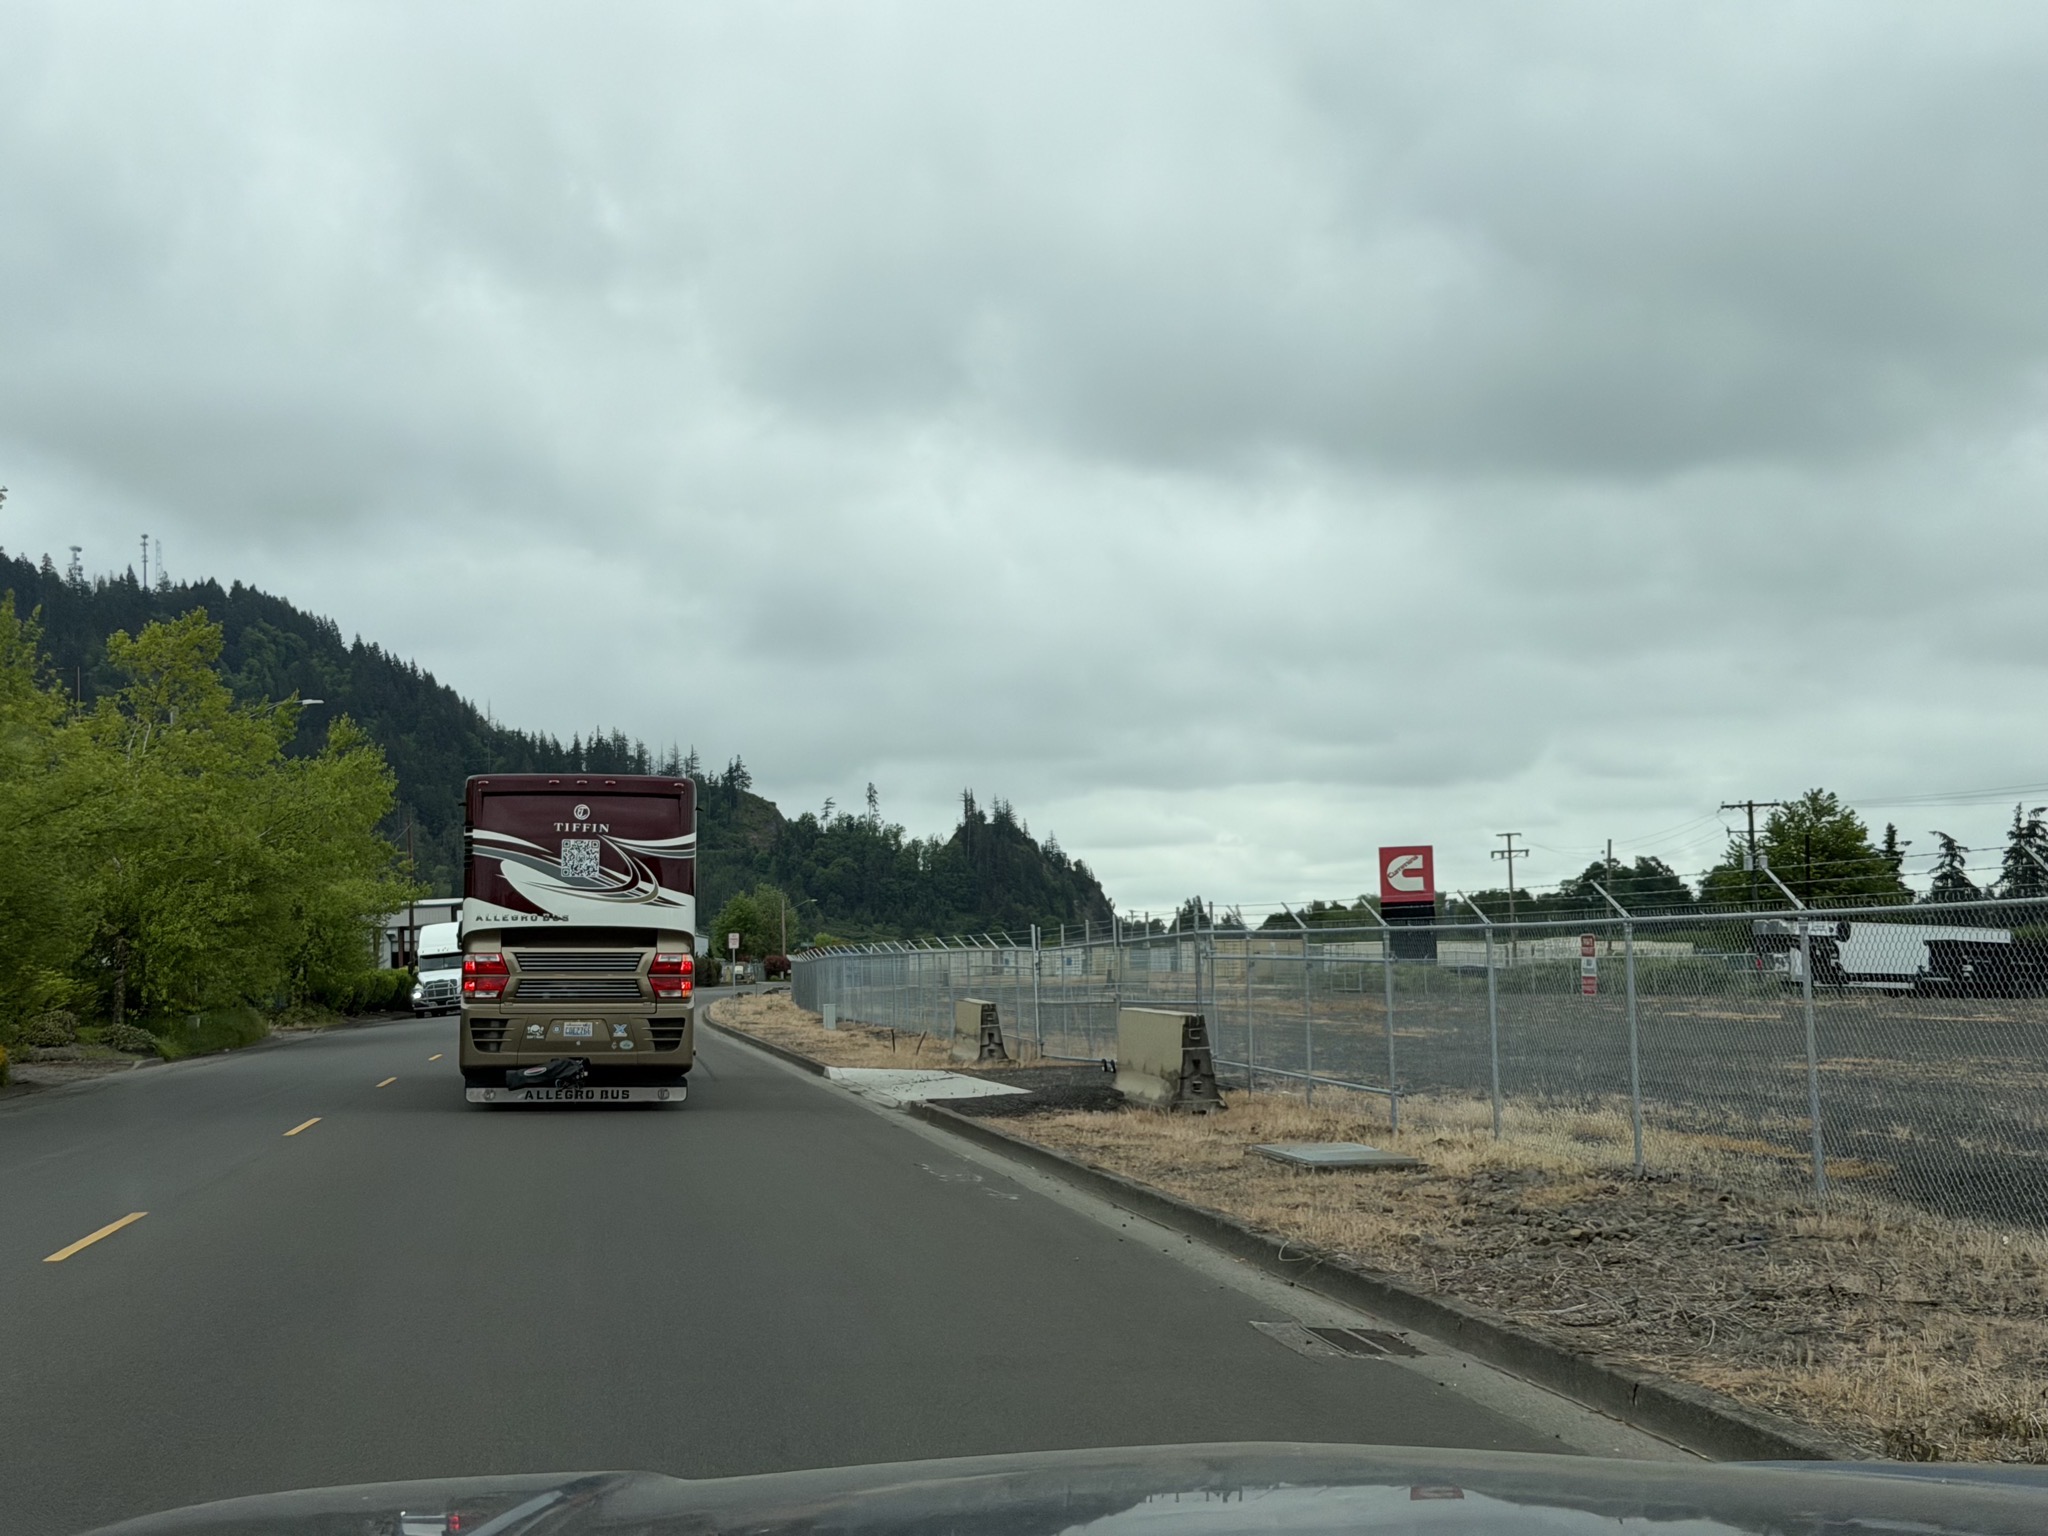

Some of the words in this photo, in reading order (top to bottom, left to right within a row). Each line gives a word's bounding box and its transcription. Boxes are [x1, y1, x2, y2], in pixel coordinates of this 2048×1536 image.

[553, 822, 610, 833] TIFFIN
[475, 913, 538, 922] ALLEGRO
[524, 1089, 595, 1100] ALLEGRO
[600, 1089, 631, 1100] BUS
